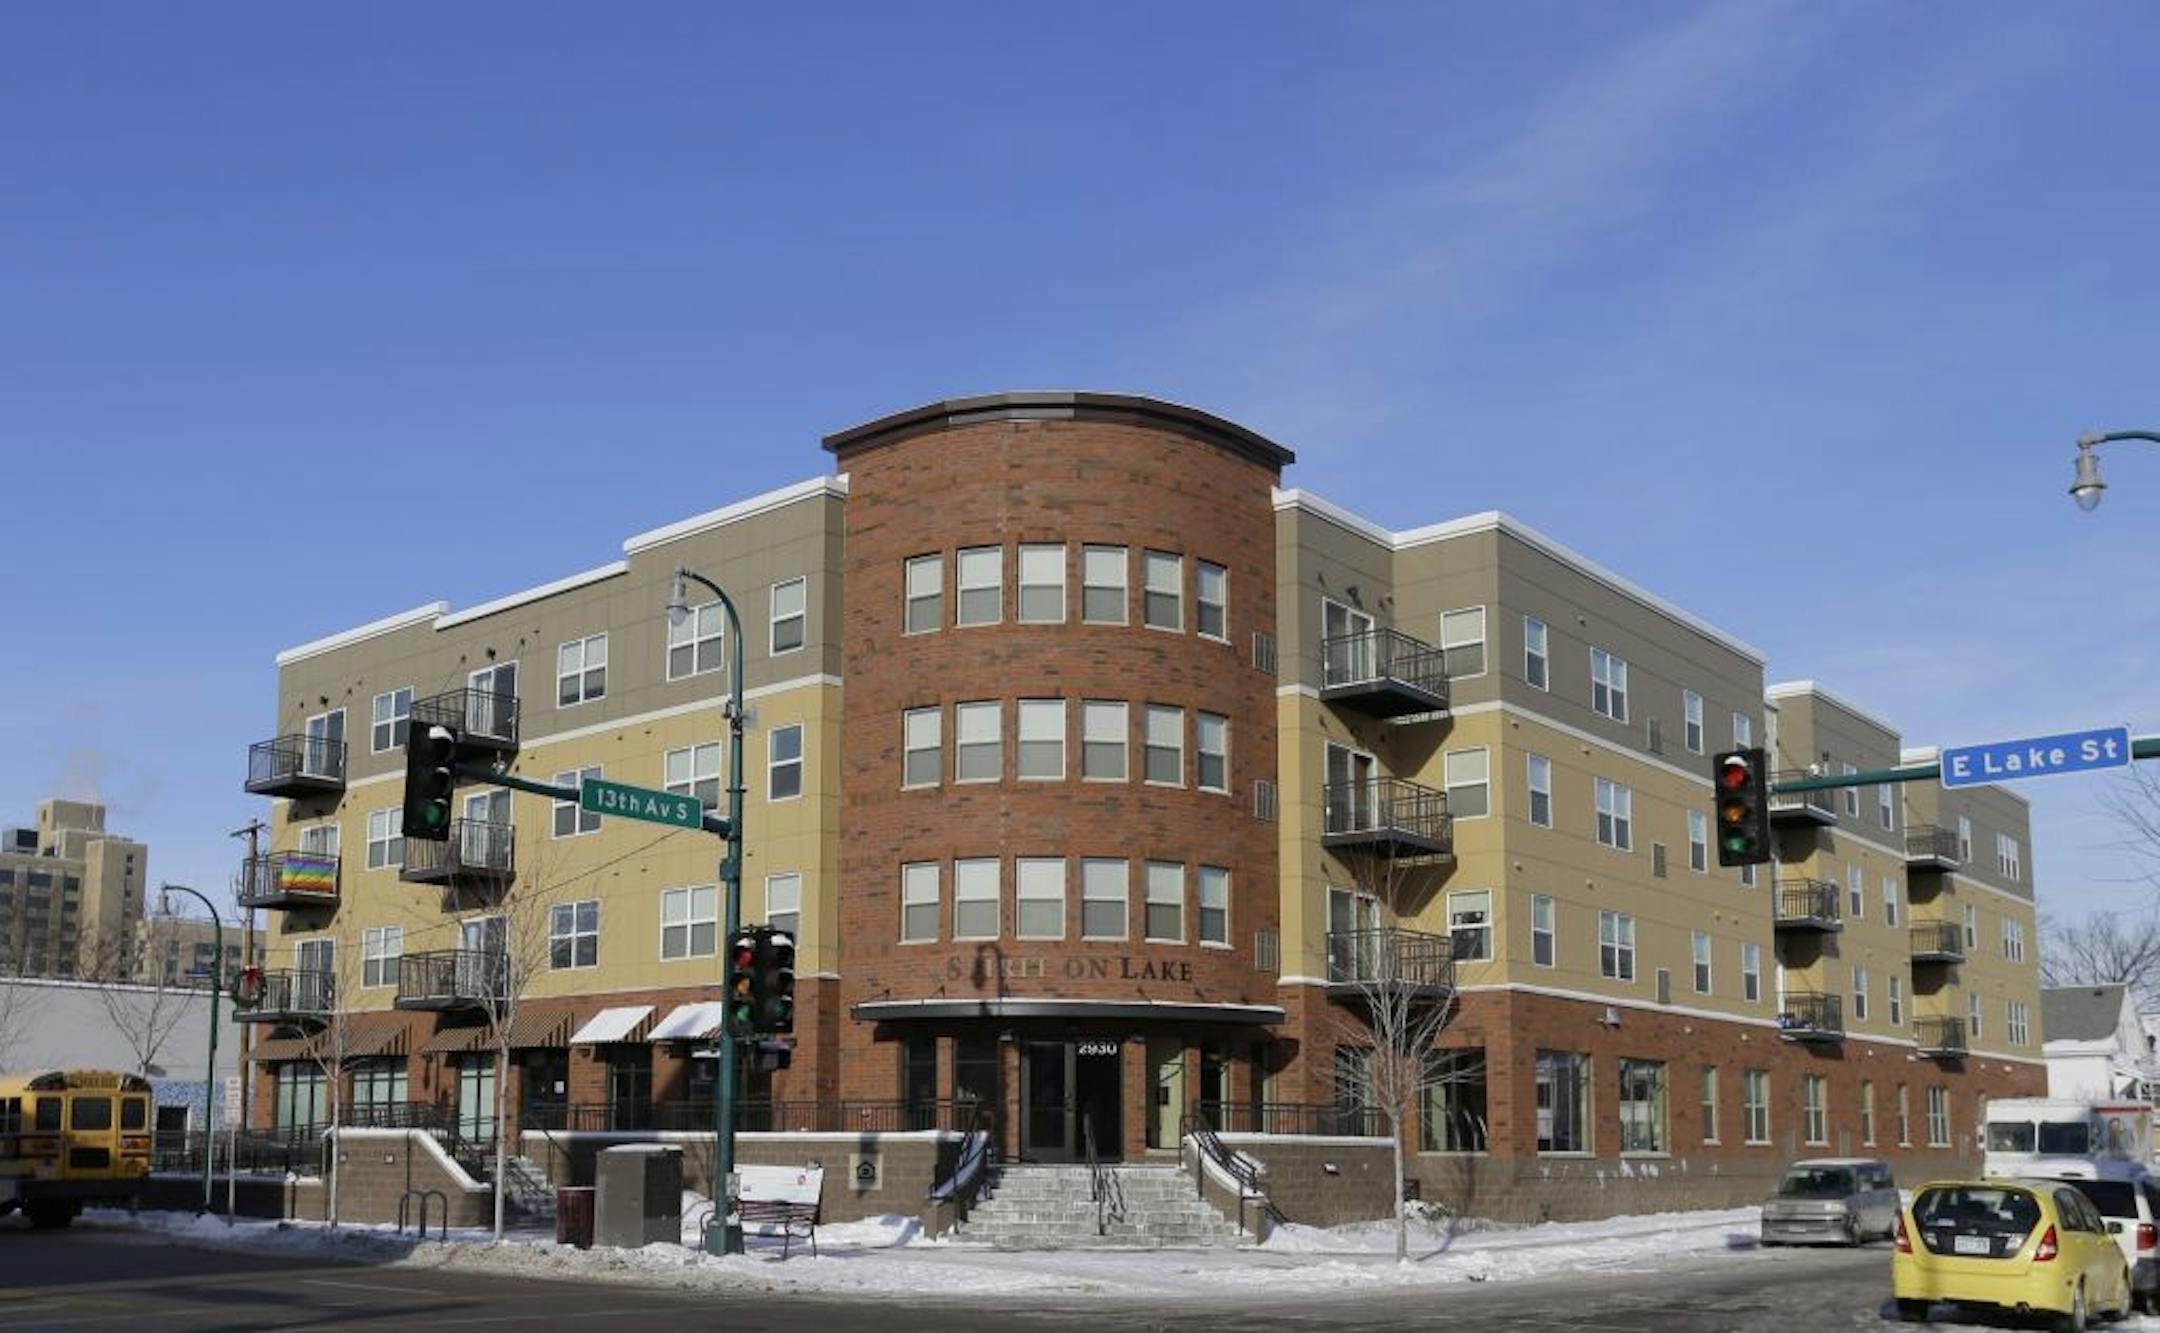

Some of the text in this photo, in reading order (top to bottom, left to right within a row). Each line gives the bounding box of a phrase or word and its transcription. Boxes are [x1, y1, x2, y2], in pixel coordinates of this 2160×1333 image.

[1952, 738, 2117, 777] E Lake St
[597, 788, 688, 819] 13th Av S
[1065, 959, 1108, 978] ON
[1120, 957, 1193, 981] LAKE
[1079, 1041, 1118, 1056] 2930
